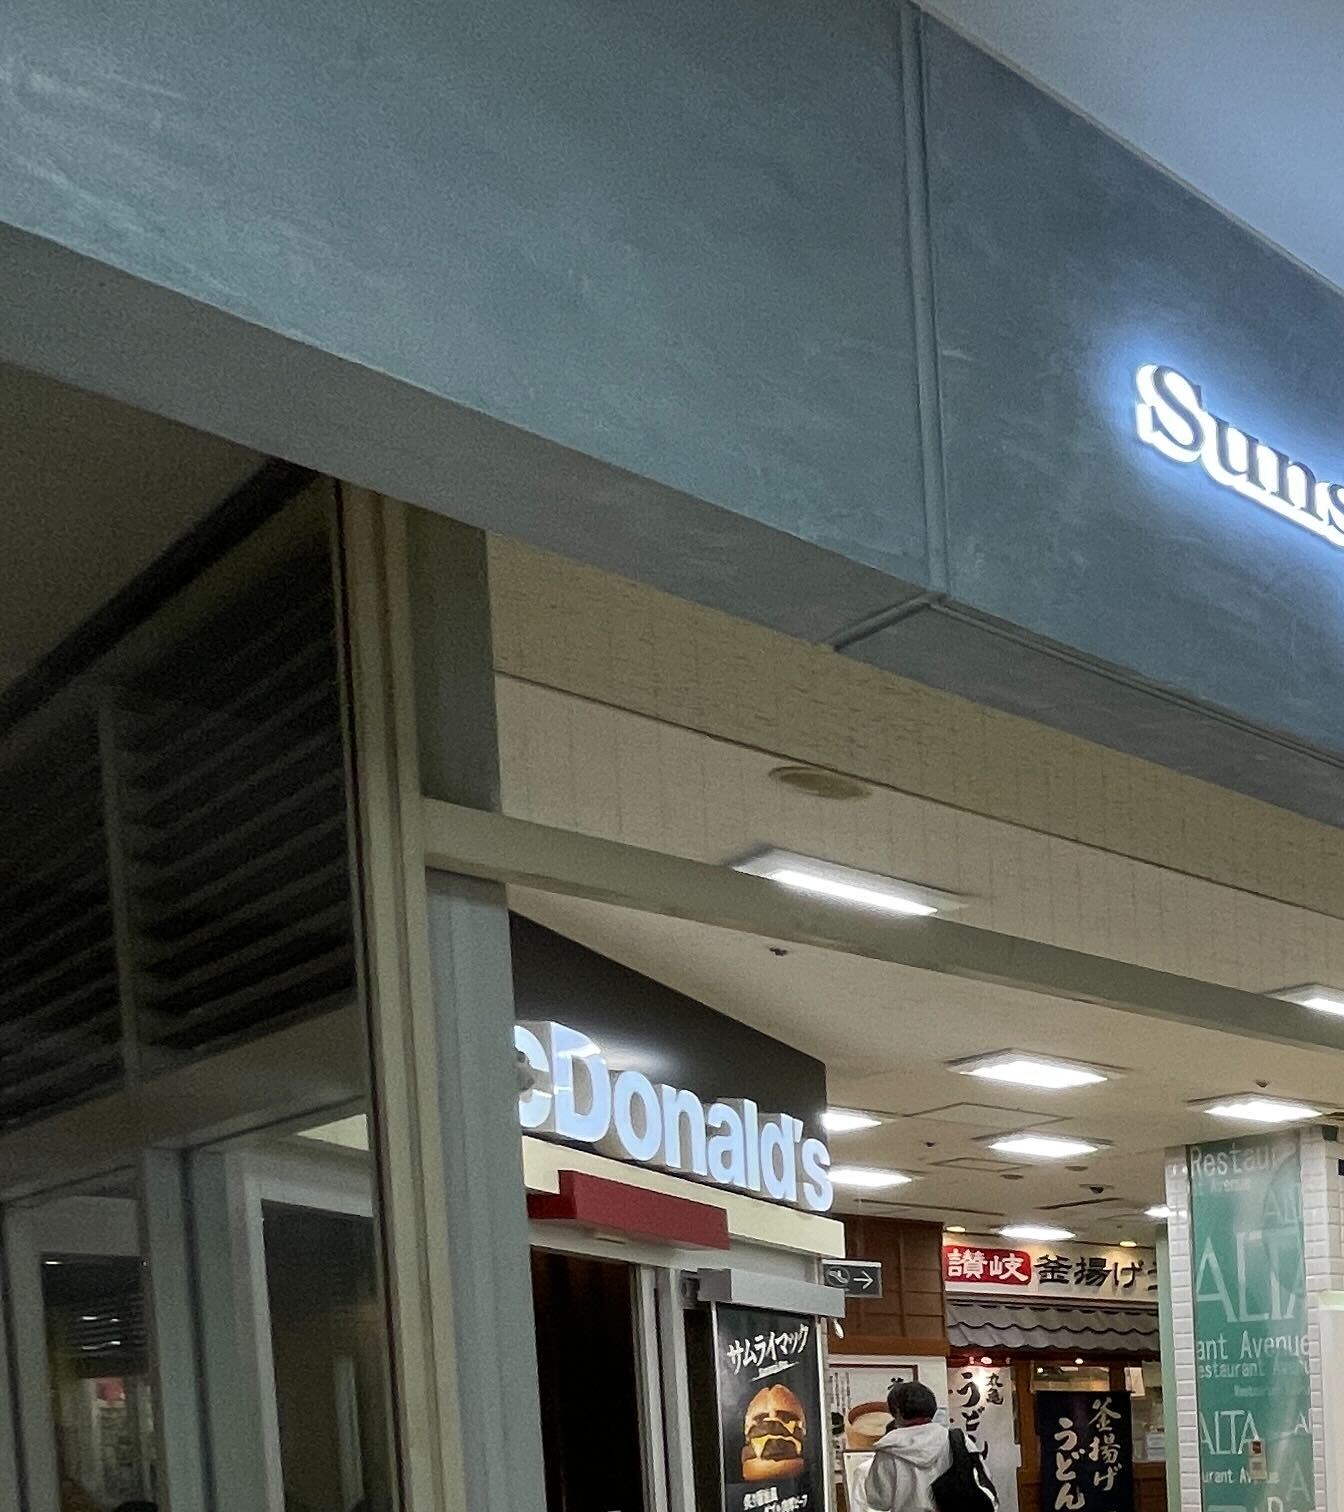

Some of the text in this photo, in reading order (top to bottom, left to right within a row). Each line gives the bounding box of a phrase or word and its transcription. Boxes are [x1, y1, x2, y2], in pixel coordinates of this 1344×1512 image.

[947, 1248, 1029, 1282] 讃岐
[726, 1323, 809, 1376] サムライマック
[1054, 1416, 1086, 1511] うどん
[1088, 1397, 1123, 1492] 釜揚げ
